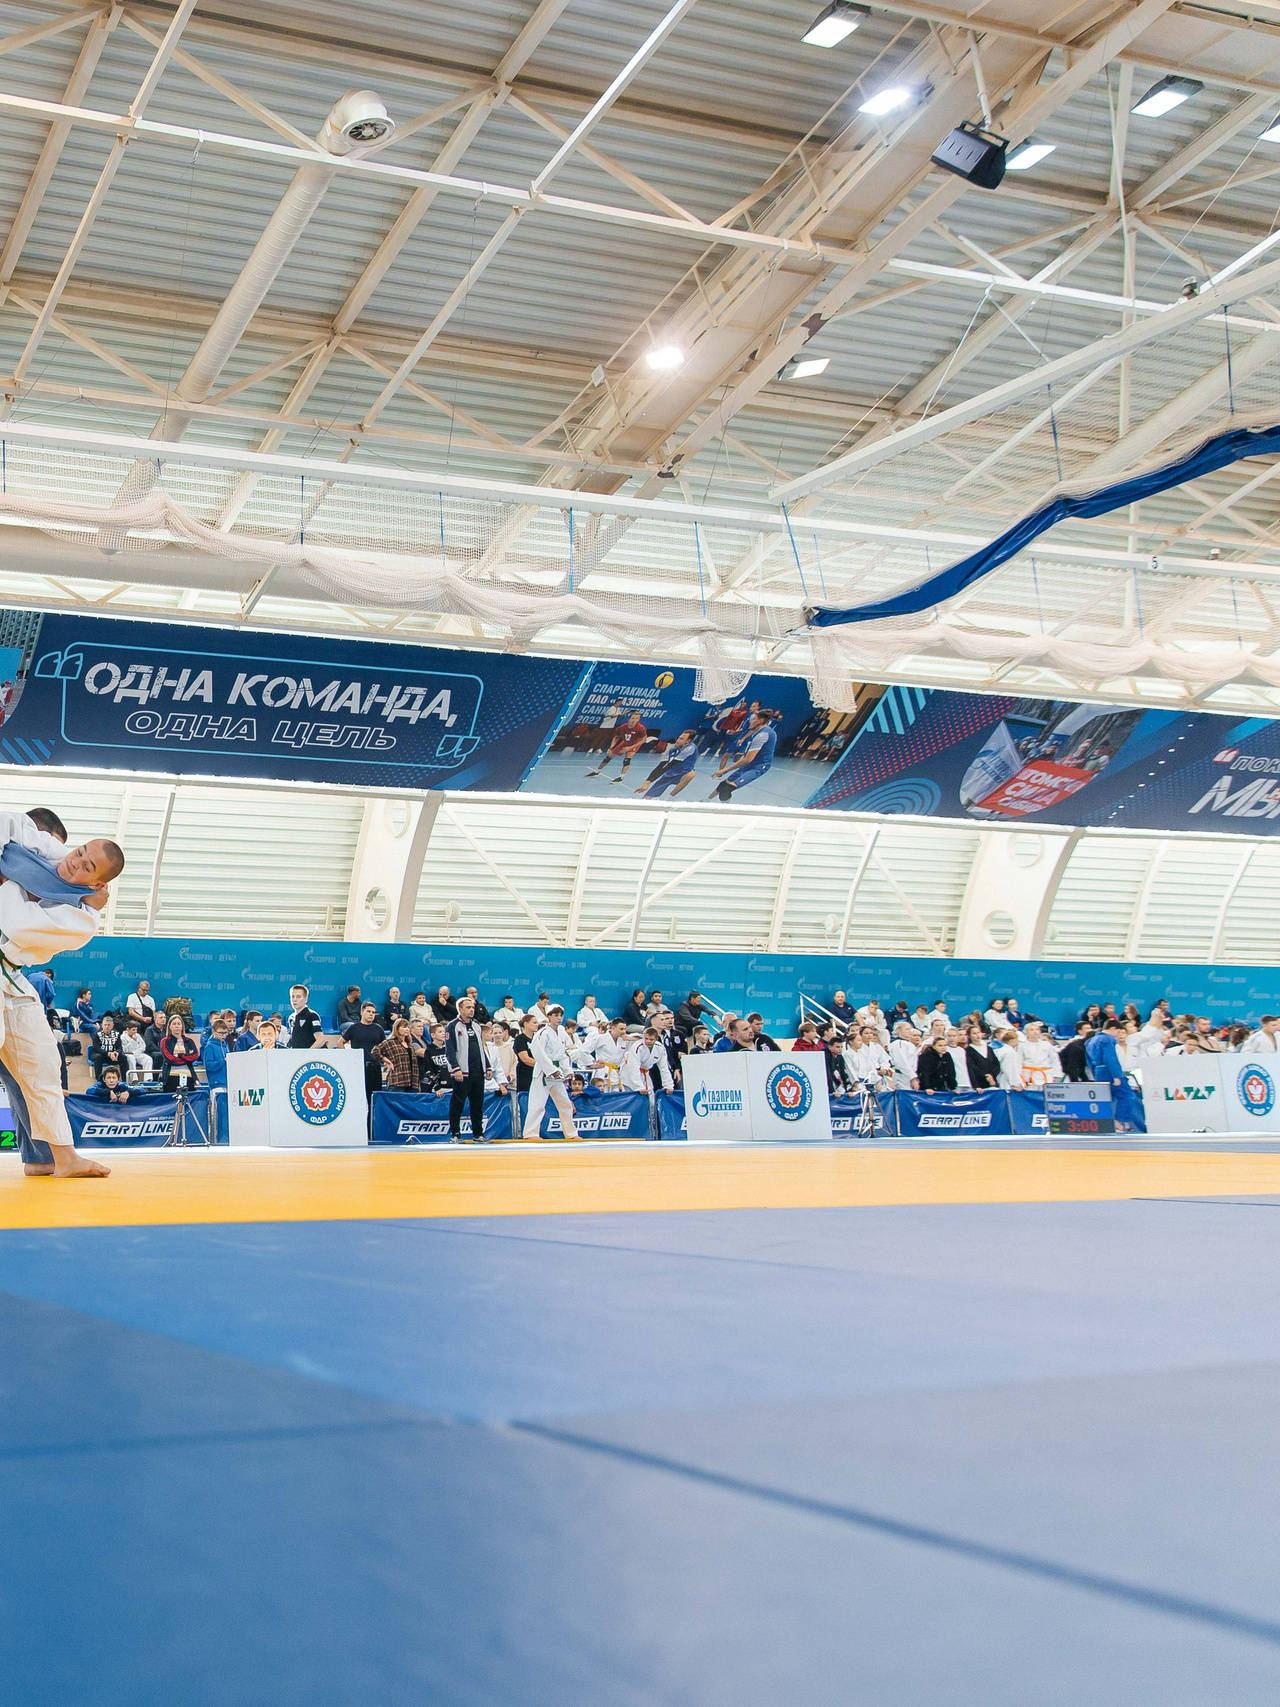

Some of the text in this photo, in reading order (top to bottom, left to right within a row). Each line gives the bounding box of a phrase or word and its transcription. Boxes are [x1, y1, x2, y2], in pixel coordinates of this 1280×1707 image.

[84, 662, 458, 727] ОДНА КОМАНДА,
[592, 683, 661, 698] СПАРТАКИАДА
[586, 693, 607, 704] ПАО
[575, 715, 601, 724] 2022
[124, 710, 397, 750] ОДНА ЦЕЛЬ
[290, 1063, 345, 1112] ФЕДЕРАЦИЯ ДЗЮДО РОССИИ
[707, 1089, 742, 1102] ГАЗПРОМ
[1088, 1090, 1096, 1100] 0
[310, 1115, 327, 1124] ФДР
[551, 1118, 628, 1129] SART LINE
[922, 1116, 987, 1125] START LINE
[85, 1125, 140, 1135] START
[401, 1123, 448, 1132] START
[1067, 1120, 1099, 1132] 3:00
